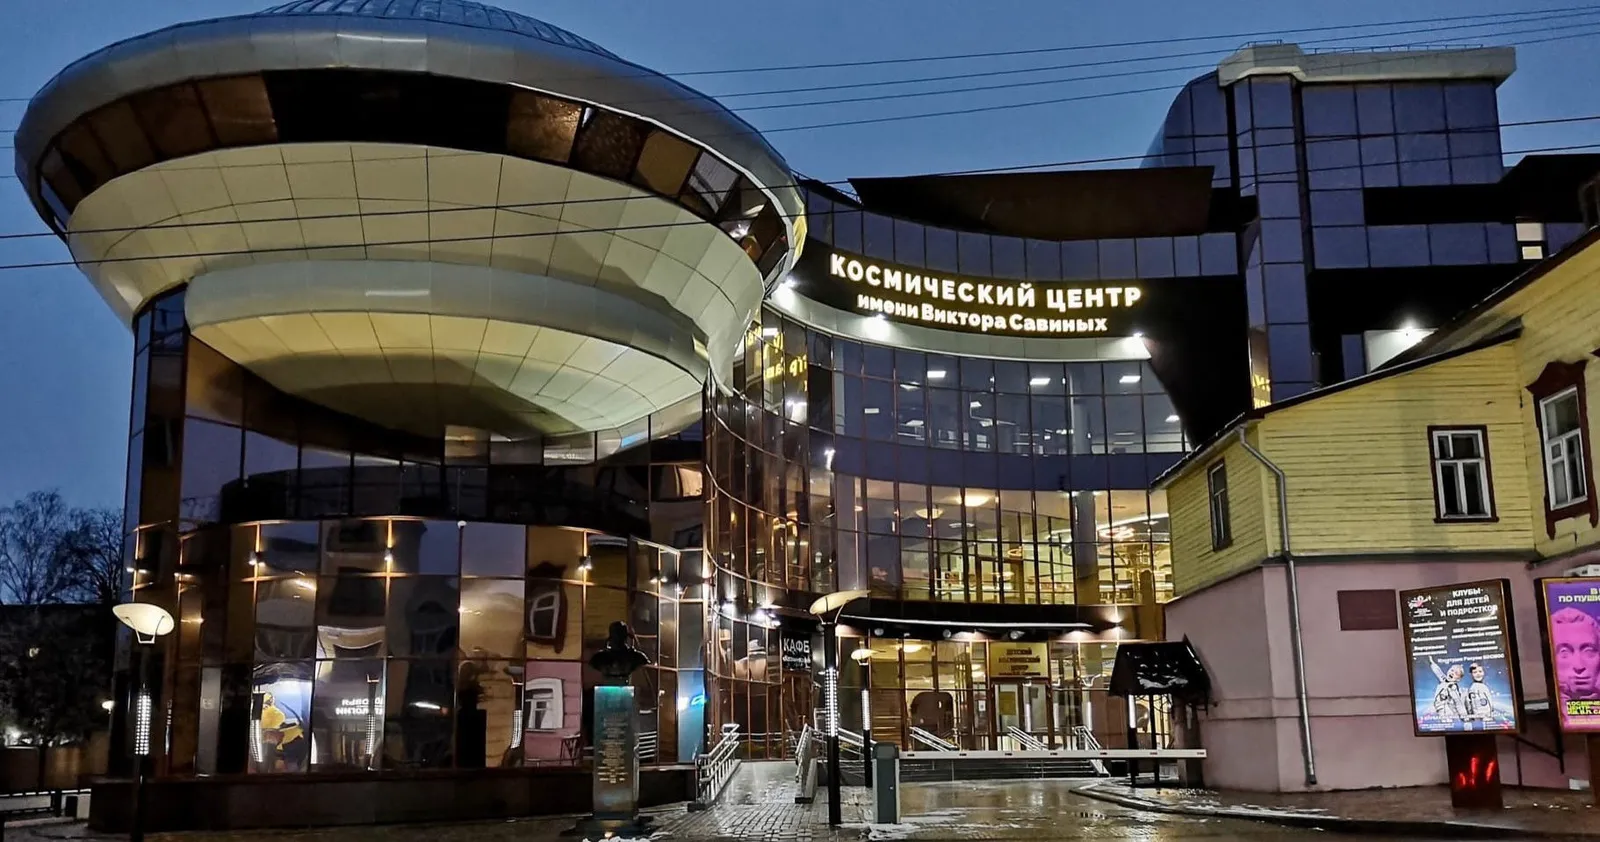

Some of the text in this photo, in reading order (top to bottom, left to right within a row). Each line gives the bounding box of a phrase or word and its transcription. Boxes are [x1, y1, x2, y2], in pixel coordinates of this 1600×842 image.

[829, 253, 1142, 313] КОСМИЧЕСКИЙ ЦЕНТР
[856, 293, 1107, 333] имени Виктора Савиных
[1452, 588, 1481, 597] КЛУБЫ
[1463, 595, 1489, 604] ДЕТЕЙ
[1558, 594, 1573, 603] ПО
